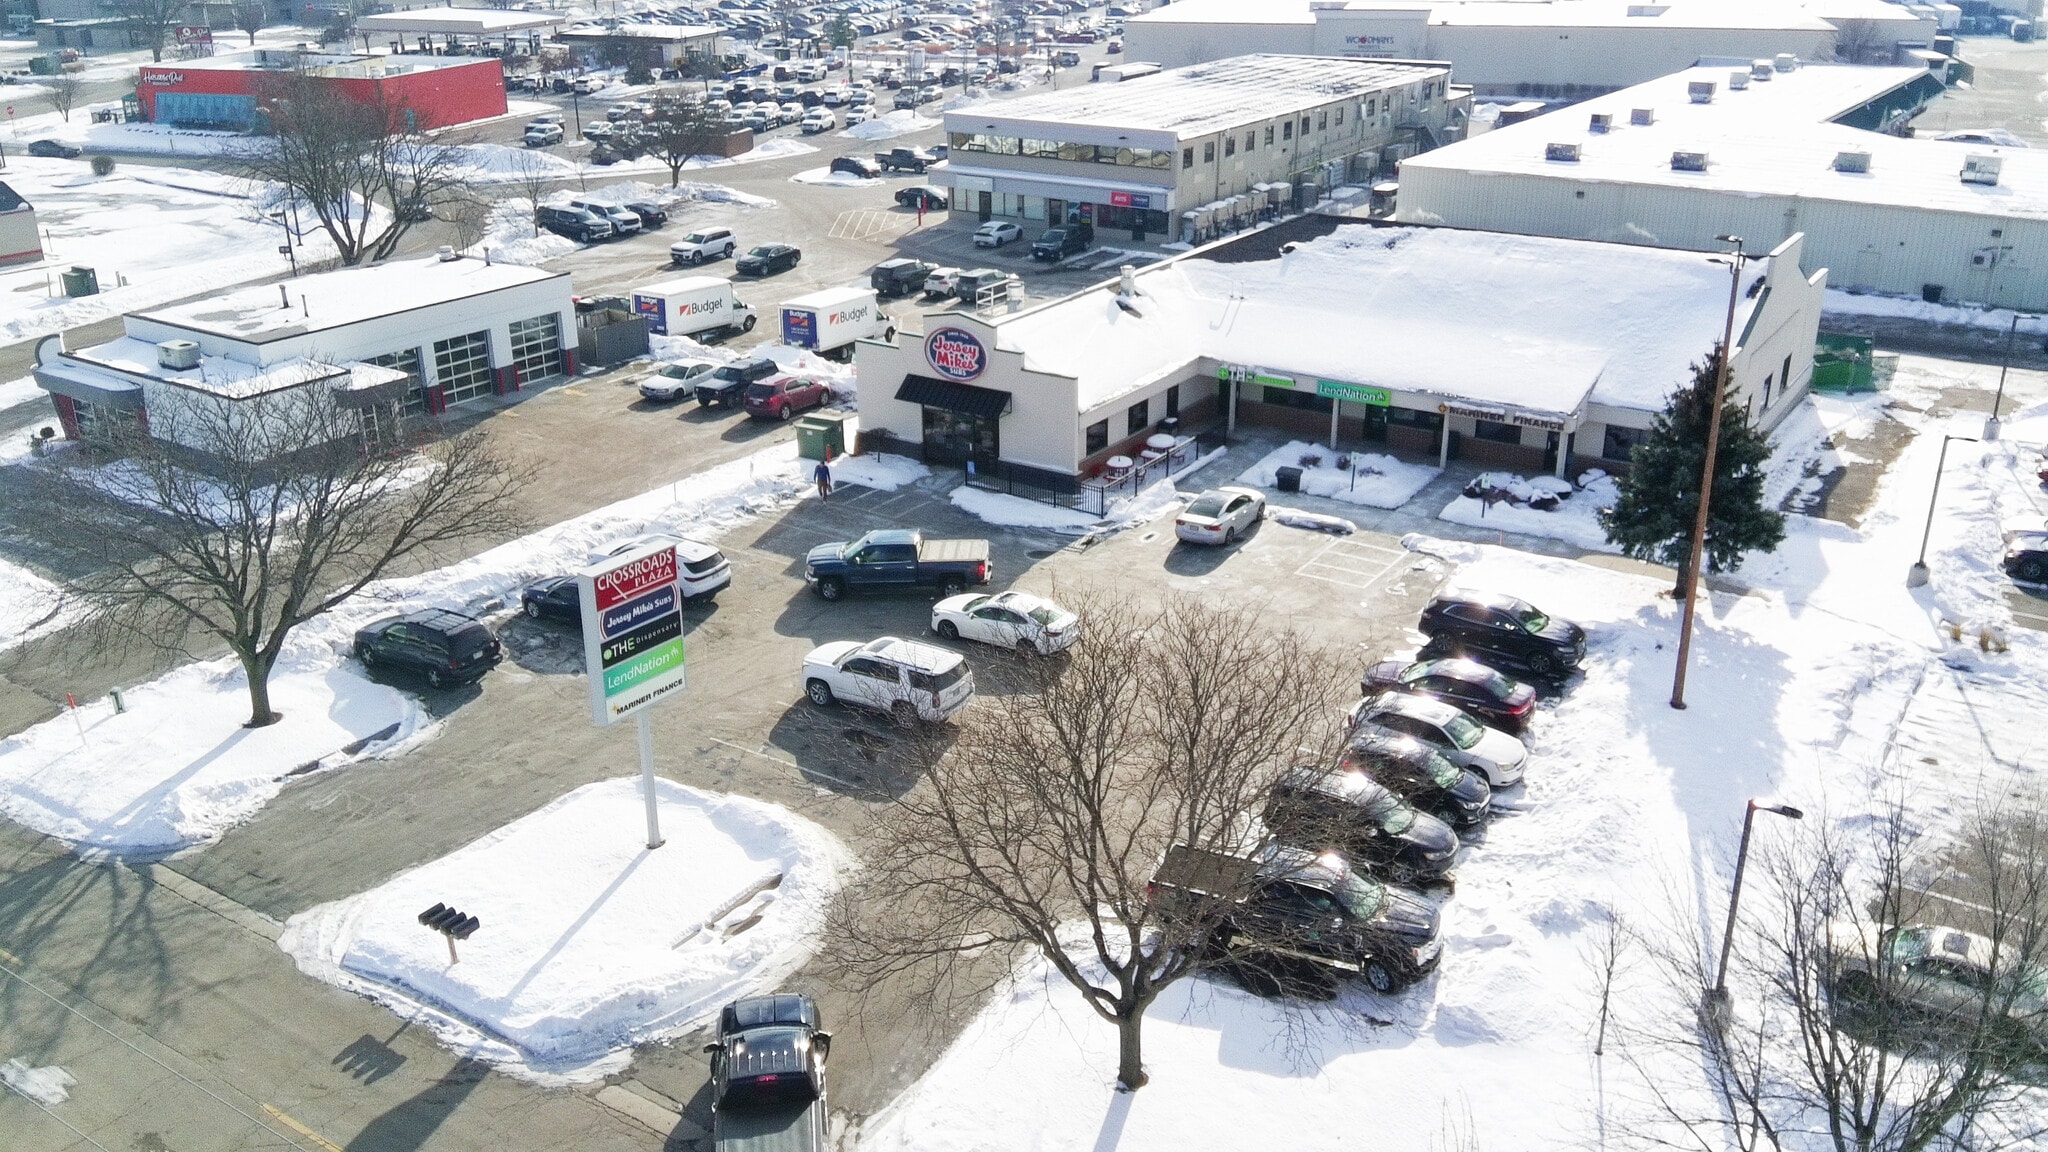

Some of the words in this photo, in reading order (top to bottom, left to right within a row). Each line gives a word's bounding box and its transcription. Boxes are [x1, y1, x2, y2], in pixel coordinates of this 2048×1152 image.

[691, 296, 723, 314] Budget
[840, 305, 868, 323] Budget
[933, 335, 979, 360] Jersey
[1319, 384, 1376, 402] LendNation
[1512, 415, 1564, 431] FINANCE
[597, 549, 673, 592] CROSSROADS
[634, 566, 672, 588] PLAZA
[607, 612, 632, 628] Jersey
[611, 637, 635, 658] THE
[608, 653, 670, 689] LendNation
[616, 693, 652, 715] MARINER
[653, 678, 683, 697] FINANCE
